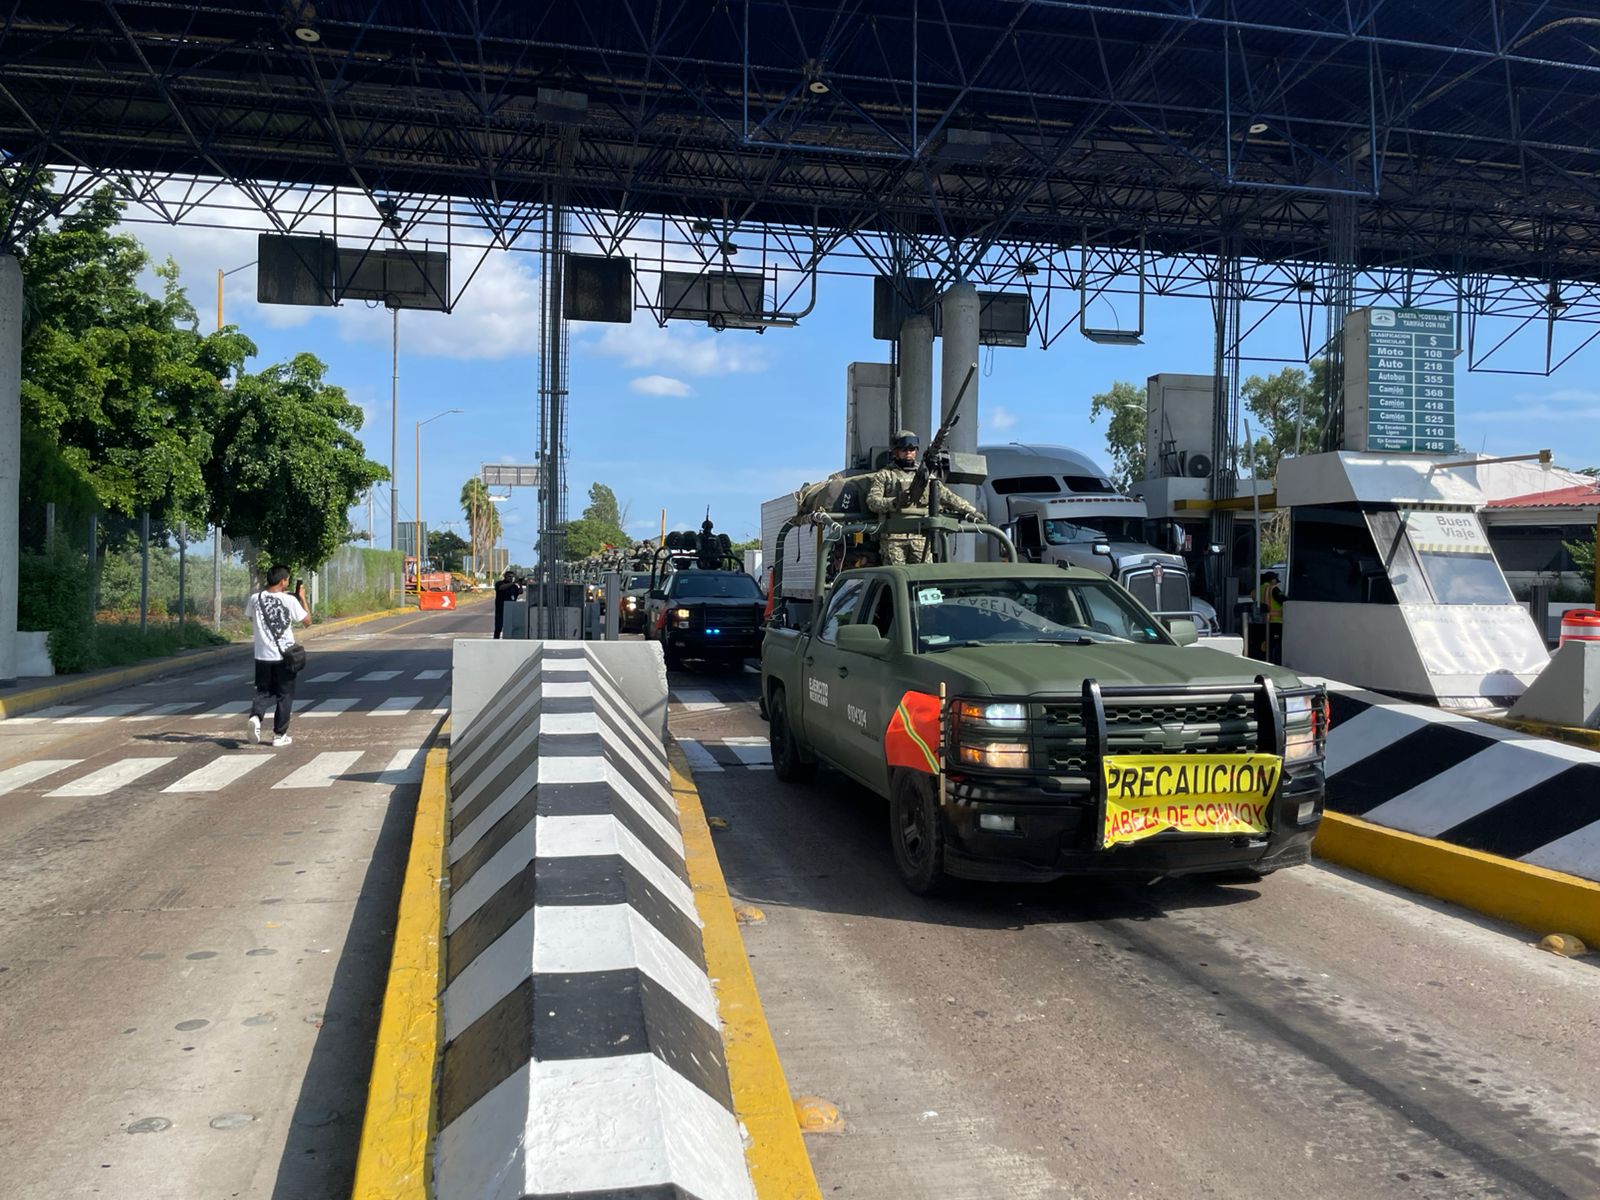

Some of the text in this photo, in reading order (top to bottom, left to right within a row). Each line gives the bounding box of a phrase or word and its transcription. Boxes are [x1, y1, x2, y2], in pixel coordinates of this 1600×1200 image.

[1429, 336, 1437, 346] $
[1377, 347, 1404, 356] Moto
[1424, 350, 1443, 358] 108
[1378, 359, 1404, 369] Auto
[1424, 362, 1443, 371] 218
[1378, 372, 1406, 381] Autobus
[1424, 375, 1444, 384] 355
[1378, 385, 1404, 393] Camión
[1424, 388, 1444, 397] 368
[1379, 399, 1405, 407] Camión
[1424, 402, 1444, 410] 418
[1380, 412, 1405, 420] Camión
[1425, 415, 1444, 424] 525
[1425, 428, 1444, 436] 110
[1425, 442, 1445, 450] 185
[1436, 515, 1472, 527] Buen
[1440, 527, 1475, 540] Viaje
[1108, 757, 1276, 799] PRECAUCIÓN
[1104, 803, 1264, 839] CABEZA DE CONVOY
